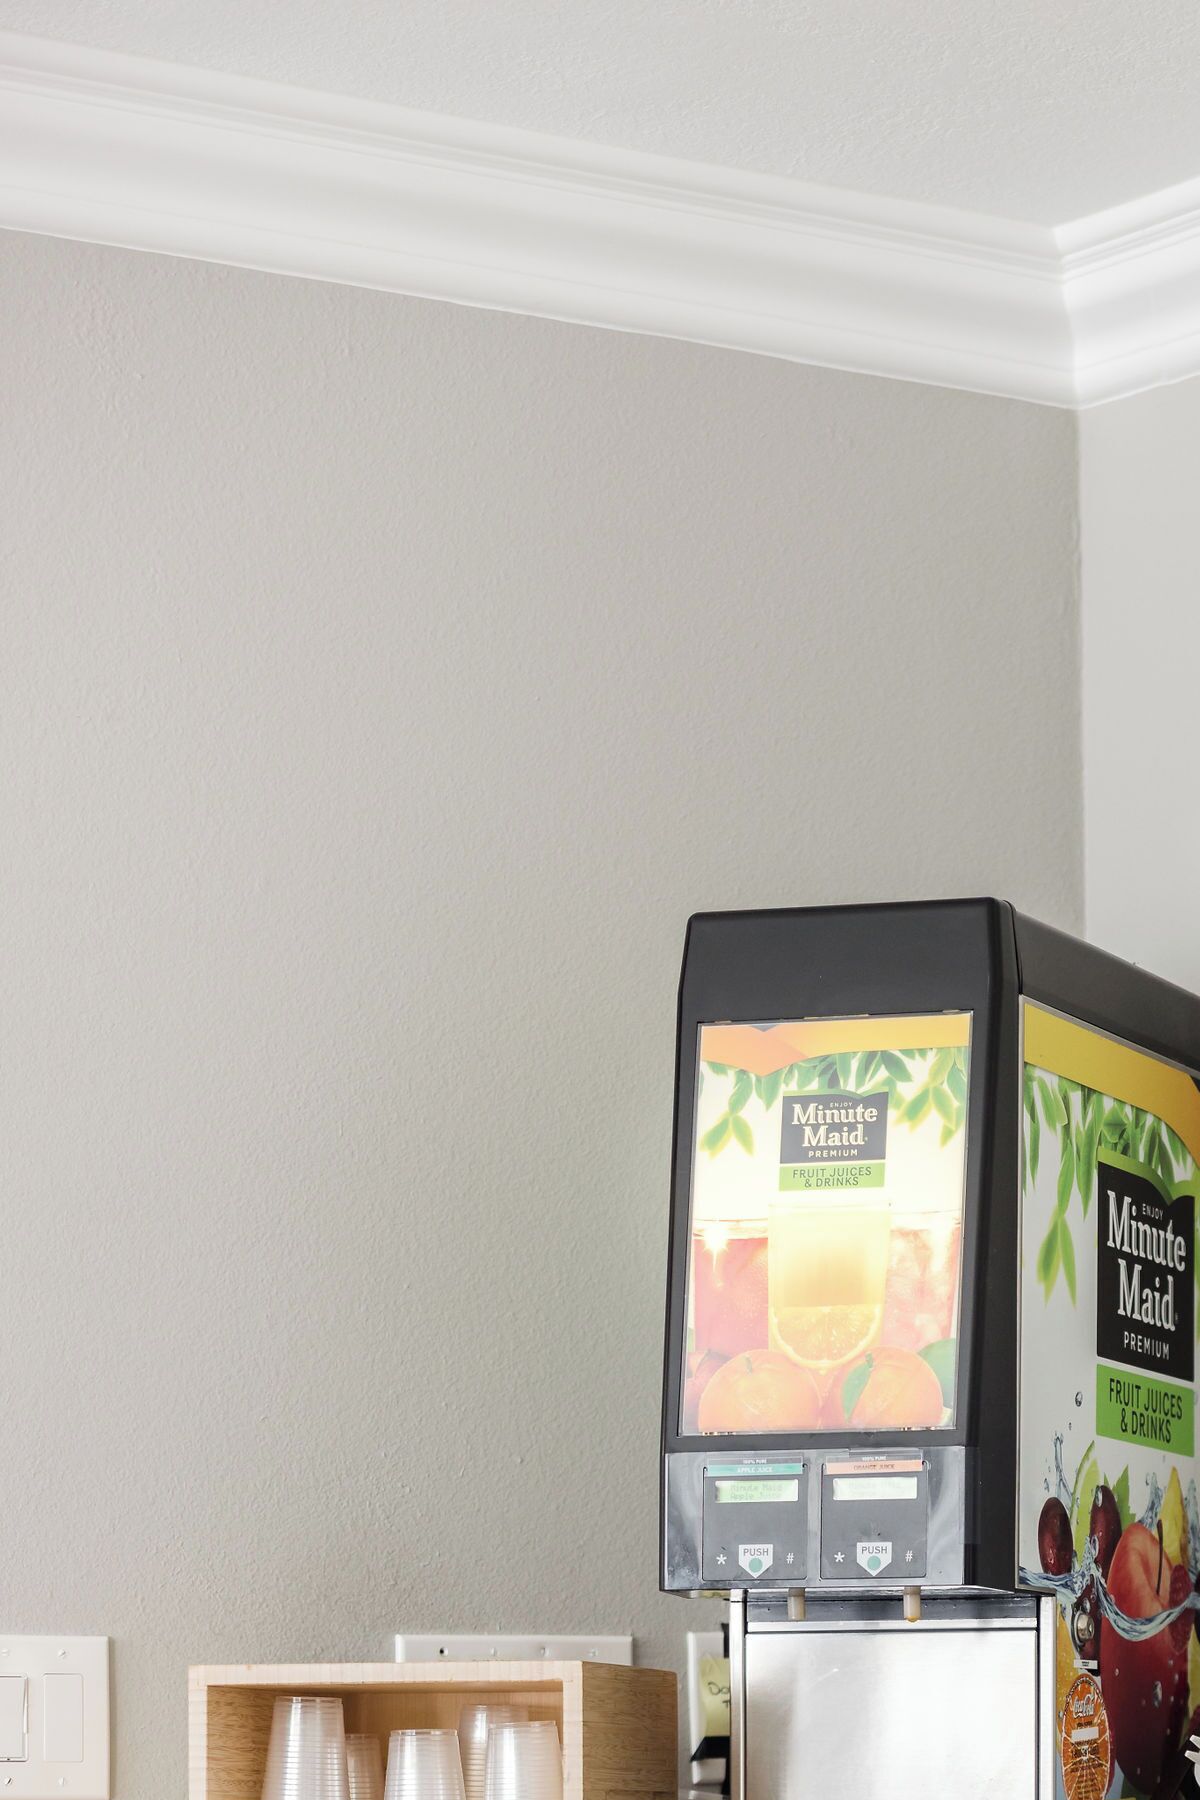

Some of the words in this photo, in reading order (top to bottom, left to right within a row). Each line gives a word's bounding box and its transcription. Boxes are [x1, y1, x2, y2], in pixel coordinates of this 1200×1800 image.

[791, 1103, 878, 1125] Minute
[802, 1123, 866, 1147] Maid
[808, 1149, 858, 1158] PREMIUM
[792, 1168, 827, 1178] FRUIT
[829, 1166, 872, 1177] JUICES
[804, 1179, 812, 1188] &
[816, 1176, 859, 1187] DRINKS
[1142, 1203, 1164, 1220] ENJOY
[1106, 1189, 1187, 1272] Minute
[1117, 1258, 1176, 1332] Maid
[1123, 1331, 1170, 1360] PREMIUM
[1109, 1378, 1142, 1409] FRUIT
[1143, 1387, 1183, 1420] JUICES
[1120, 1408, 1128, 1433] &
[1131, 1411, 1171, 1444] DRINKS
[743, 1547, 769, 1557] PUSH
[861, 1545, 888, 1555] PUSH
